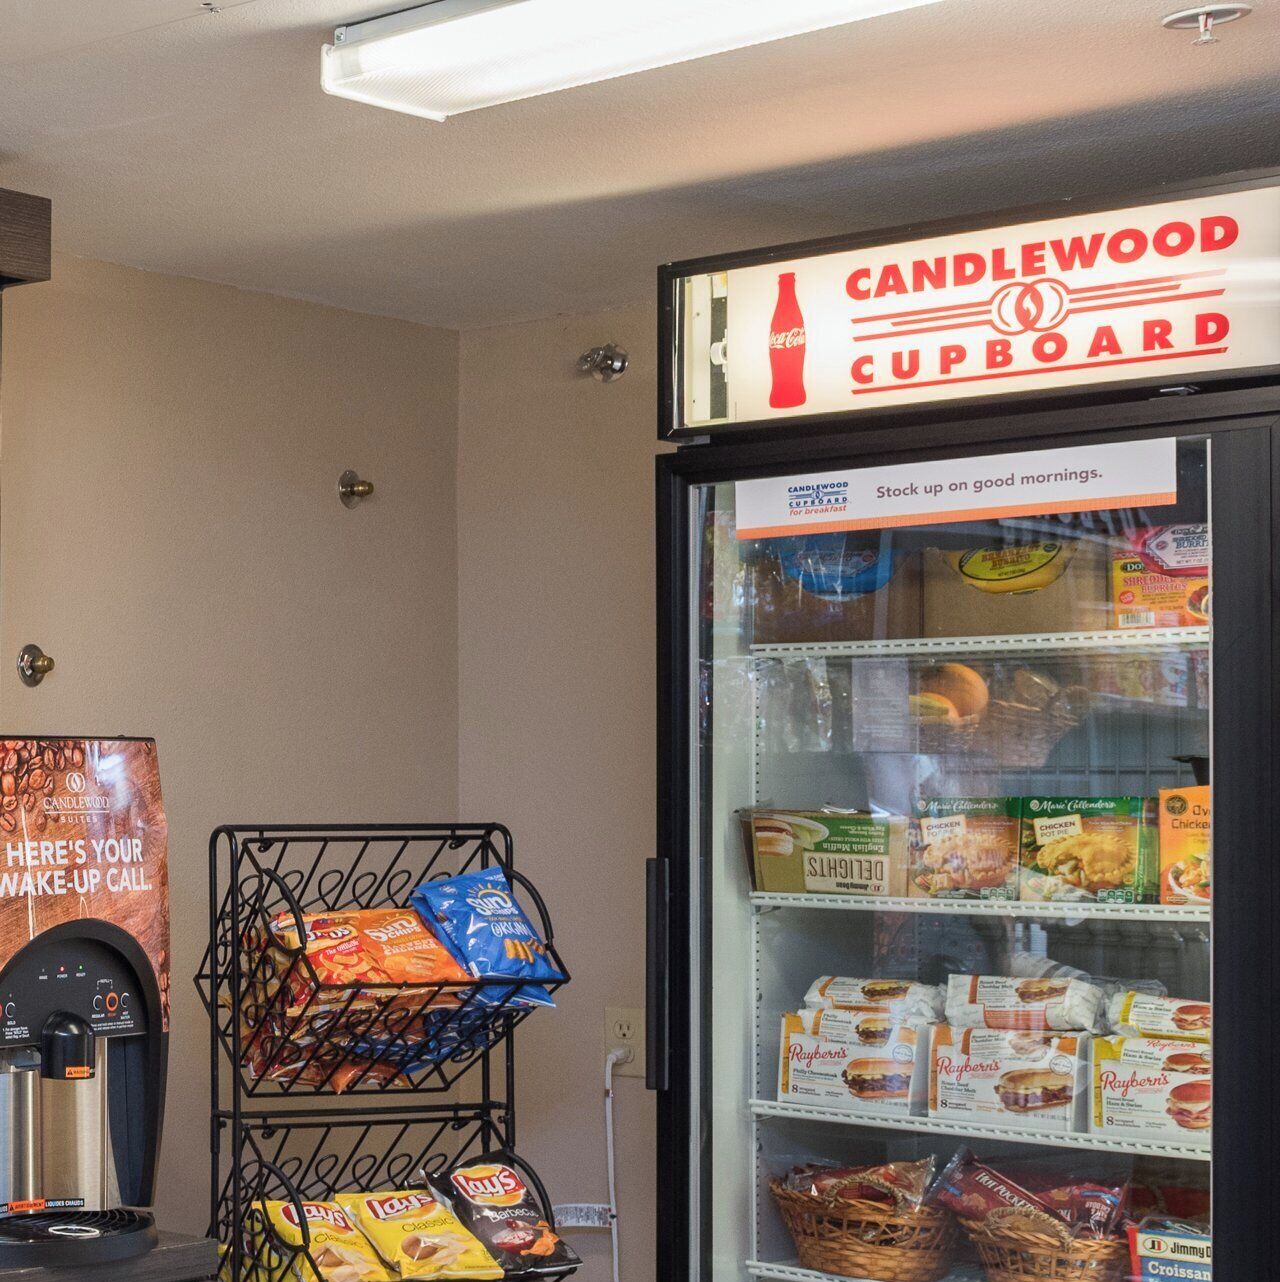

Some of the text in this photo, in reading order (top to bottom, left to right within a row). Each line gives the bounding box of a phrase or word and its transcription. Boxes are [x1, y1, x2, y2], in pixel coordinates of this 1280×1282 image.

[845, 215, 1239, 300] CANDLEWOOD
[850, 312, 1230, 384] CUPBOARD
[787, 481, 849, 493] CANDLEWOOD
[876, 467, 1103, 500] Stock up on good mornings.
[789, 504, 847, 516] for breakfast
[926, 821, 962, 832] CHICKEN
[1040, 820, 1076, 833] CHICKEN
[6, 838, 143, 867] HERE'S YOUR
[107, 868, 153, 891] CALL.
[809, 857, 884, 881] DELIGHTS
[789, 1043, 848, 1070] Raybern's
[937, 1057, 1001, 1086] Raybern's
[1101, 1069, 1171, 1098] Raybern's
[460, 1168, 518, 1197] Lay's
[975, 1171, 994, 1189] HOT
[376, 1193, 434, 1218] Lay's
[401, 1216, 454, 1234] Classic
